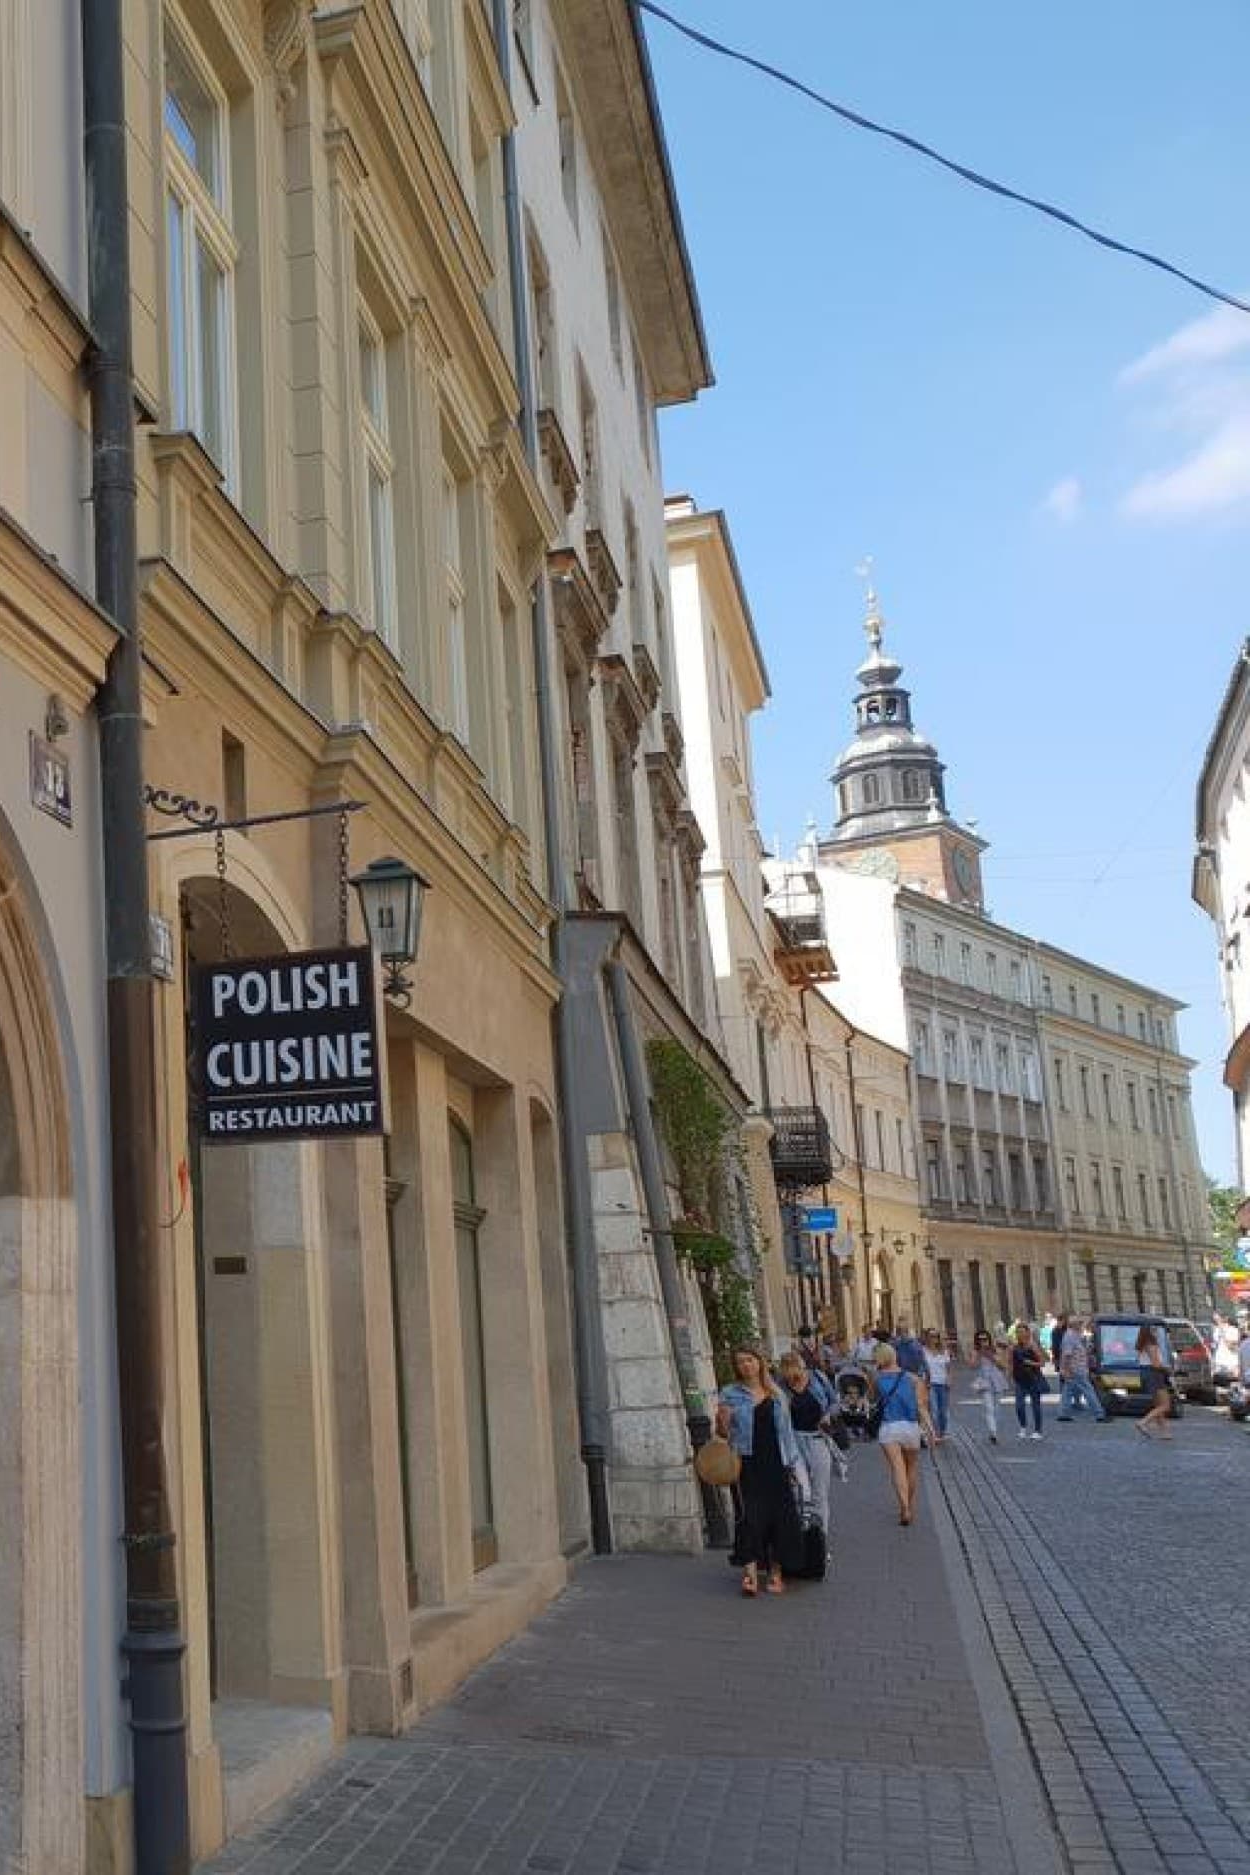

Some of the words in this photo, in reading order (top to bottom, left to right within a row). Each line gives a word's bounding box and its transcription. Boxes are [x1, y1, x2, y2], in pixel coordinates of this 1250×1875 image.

[212, 961, 359, 1018] POLISH
[206, 1032, 373, 1087] CUISINE
[209, 1100, 377, 1132] RESTAURANT
